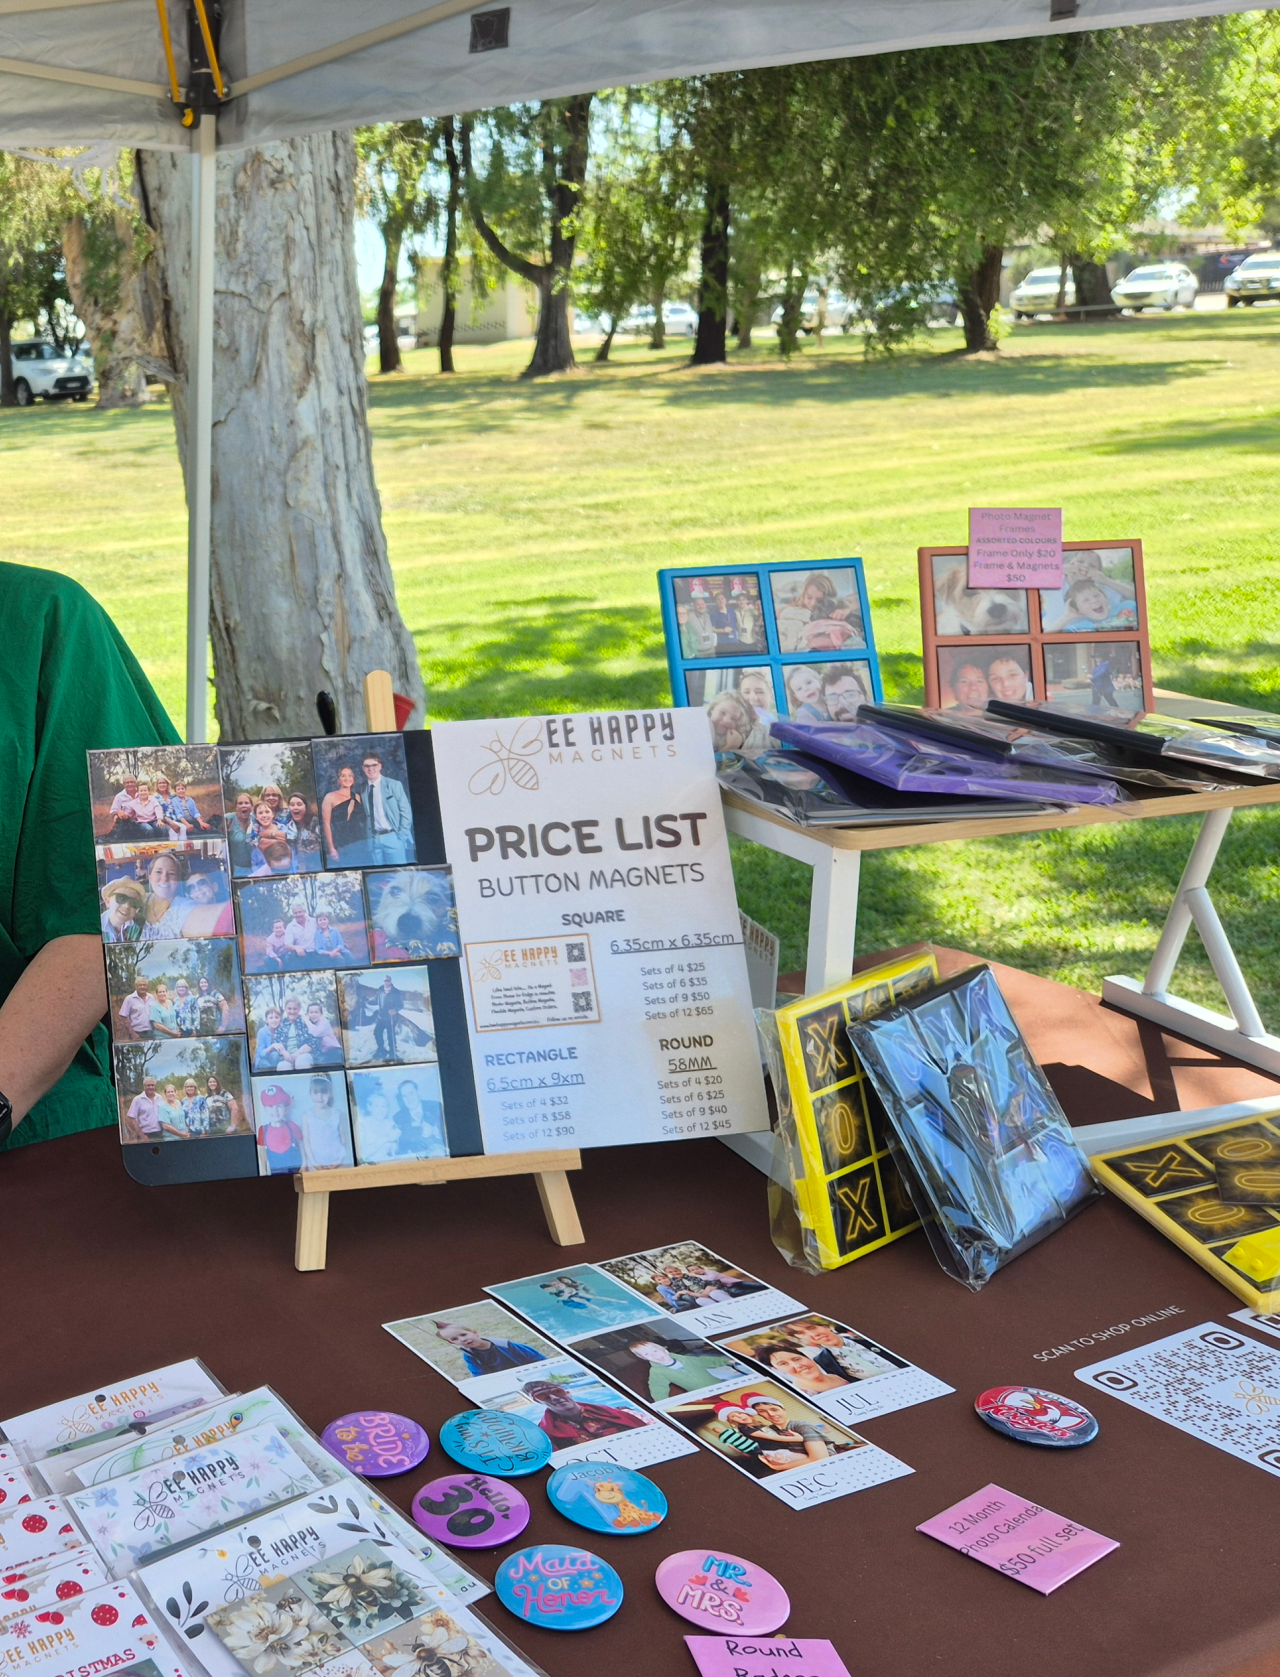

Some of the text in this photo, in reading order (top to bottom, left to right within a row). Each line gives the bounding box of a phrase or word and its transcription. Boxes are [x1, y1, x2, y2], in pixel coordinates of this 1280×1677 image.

[982, 512, 1051, 522] Photo Magnet
[977, 549, 1056, 559] Frame Only $20
[974, 561, 1005, 569] Frame
[1017, 562, 1059, 571] Magnets
[1006, 574, 1026, 582] $50
[590, 712, 676, 746] HAPPY
[549, 744, 677, 765] MAGNETS
[464, 812, 707, 862] PRICE LIST
[478, 862, 705, 899] BUTTON MAGNETS
[561, 909, 626, 928] SQUARE
[610, 933, 735, 953] 6.35cm x 6.35cm
[521, 946, 558, 961] HAPPY
[505, 960, 558, 969] MAGNETS
[640, 962, 705, 976] Sets of 4 $25
[642, 977, 708, 991] Sets of 6 $35
[644, 991, 710, 1006] Sets of 9 $50
[645, 1006, 714, 1021] Sets of 12 $65
[659, 1034, 714, 1051] ROUND
[484, 1046, 578, 1066] RECTANGLE
[668, 1056, 713, 1072] 58MM
[486, 1072, 584, 1091] 6.5cm x 9xm
[657, 1075, 722, 1090] Sets of 4 $20
[501, 1096, 569, 1111] Sets of 4 $32
[660, 1090, 725, 1105] Sets of 6 $25
[502, 1116, 525, 1126] Sets
[528, 1113, 538, 1123] of
[551, 1110, 571, 1122] $58
[661, 1105, 728, 1119] Sets of 9 $40
[503, 1126, 575, 1141] Sets of 12 $90
[662, 1119, 732, 1135] Sets of 12 $45
[695, 1311, 733, 1329] JAN
[1033, 1305, 1186, 1362] SCAN TO SHOP ONLINE
[110, 1381, 161, 1407] HAPPY
[836, 1393, 879, 1415] JUL
[359, 1412, 410, 1469] BRIDE
[186, 1456, 240, 1486] HAPPY
[570, 1467, 614, 1481] Jacob
[173, 1471, 246, 1503] MAGNETS
[780, 1472, 838, 1499] DEC
[418, 1484, 495, 1537] 30
[948, 1500, 1006, 1535] 12 Month
[270, 1526, 321, 1557] HAPPY
[960, 1531, 1000, 1555] Photo
[999, 1523, 1084, 1576] $50 full set
[259, 1541, 327, 1576] MAGNETS
[509, 1552, 599, 1578] Maid
[547, 1577, 571, 1590] OF
[710, 1579, 729, 1595] &
[513, 1583, 617, 1617] Honor
[27, 1628, 76, 1655] HAPPY
[725, 1640, 803, 1658] Round
[12, 1642, 80, 1671] MAGNETS
